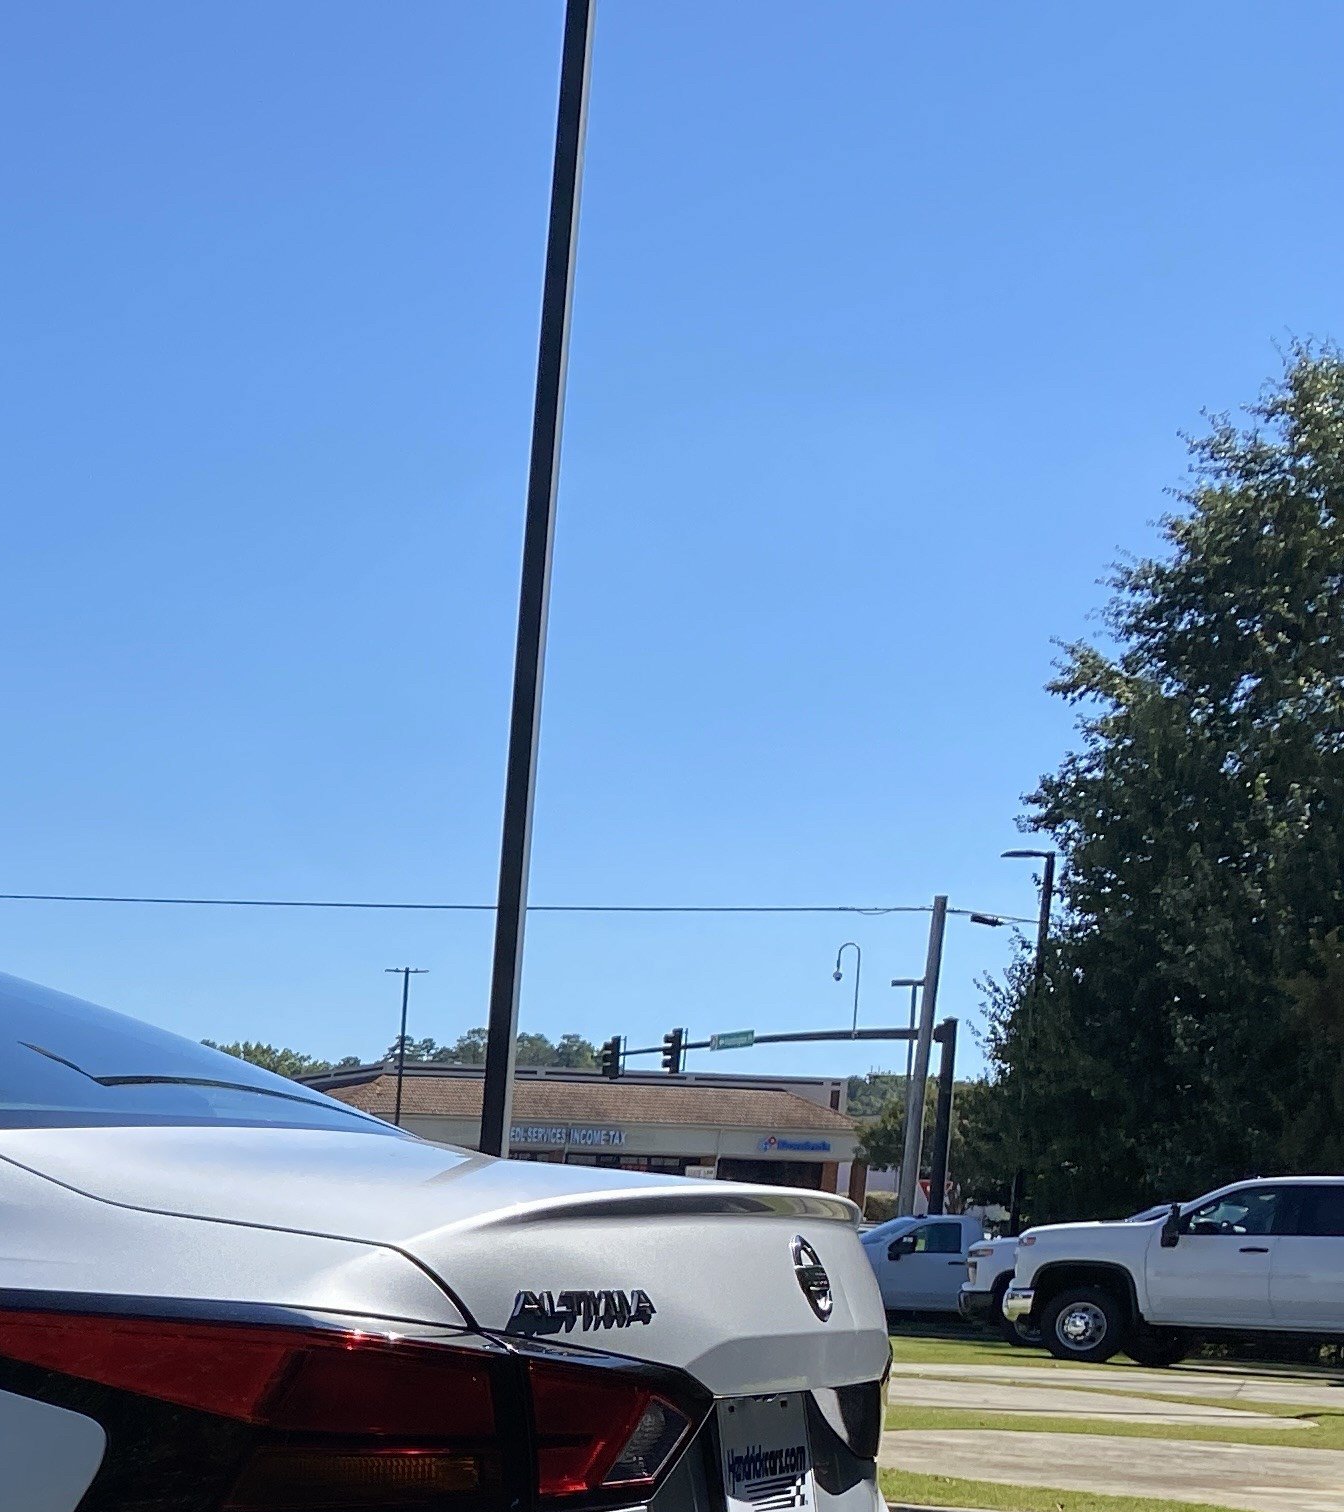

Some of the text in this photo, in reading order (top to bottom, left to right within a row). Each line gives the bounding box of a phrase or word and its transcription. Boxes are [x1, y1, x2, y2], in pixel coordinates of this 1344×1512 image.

[526, 1126, 567, 1145] SERVICES
[569, 1128, 607, 1146] INCOME
[608, 1129, 628, 1146] TAX
[512, 1289, 657, 1318] ALTIMA
